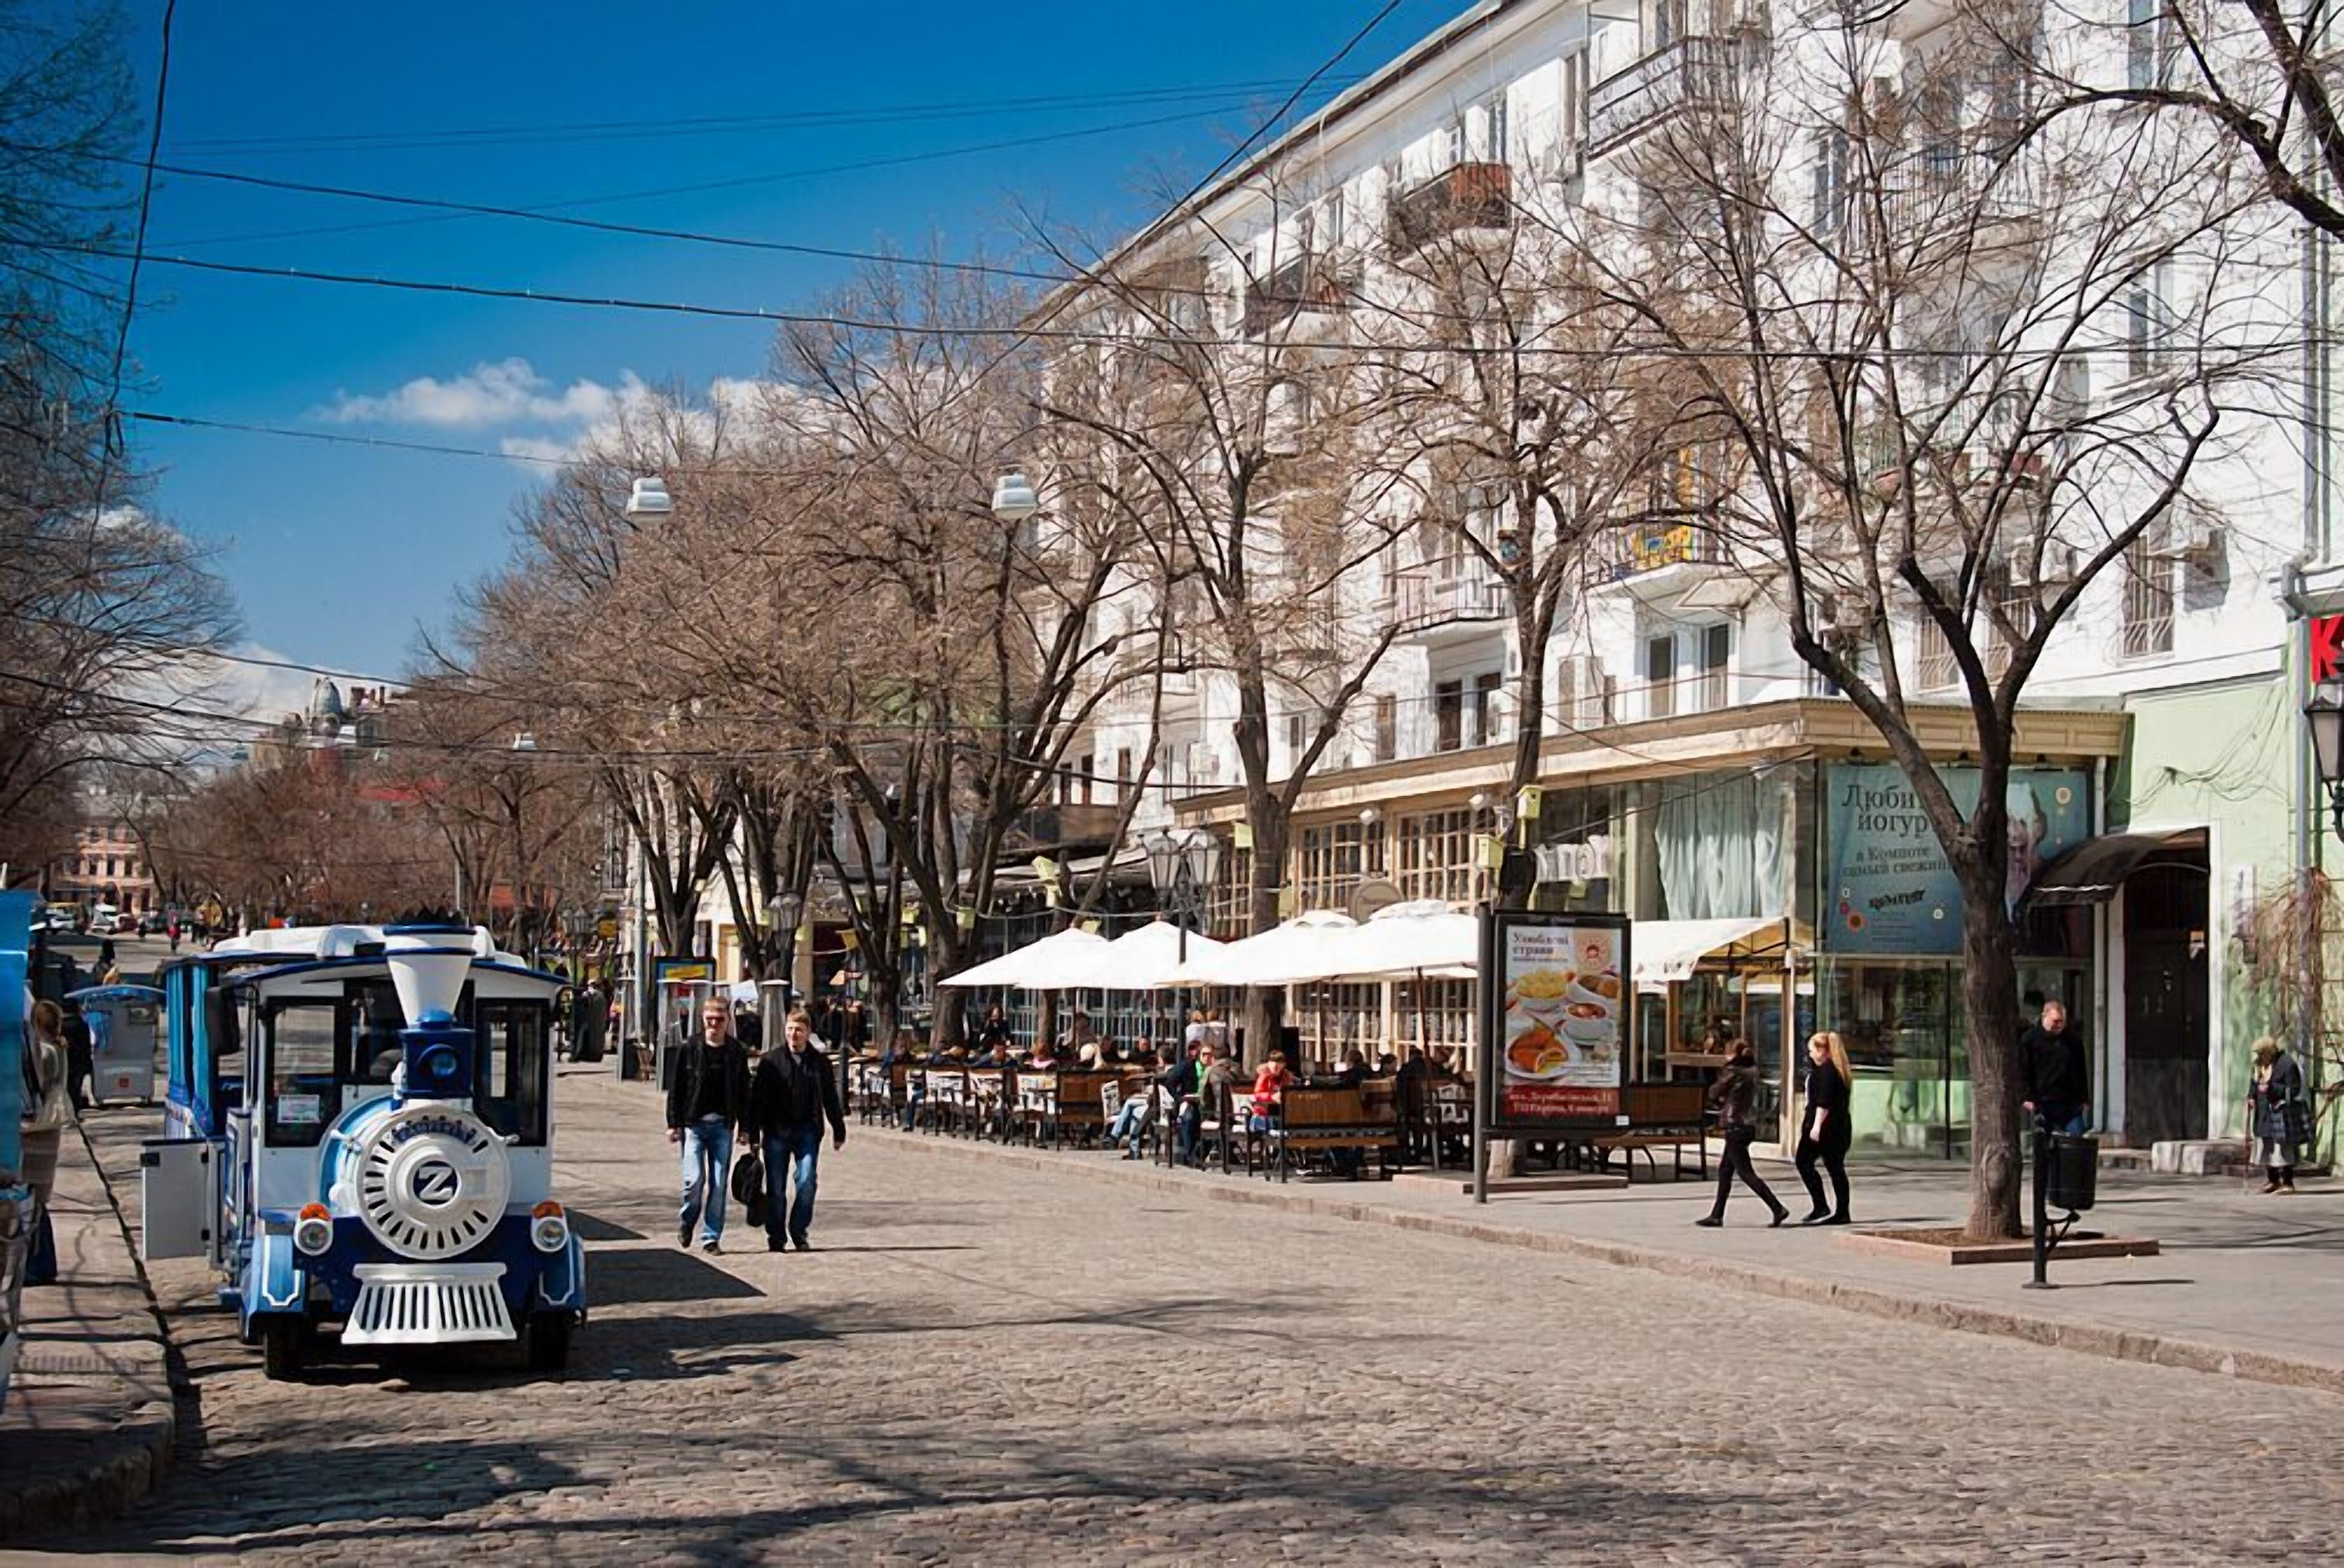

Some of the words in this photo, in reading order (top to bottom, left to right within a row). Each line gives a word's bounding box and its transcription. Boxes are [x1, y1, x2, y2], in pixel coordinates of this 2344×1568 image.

[1842, 785, 1924, 811] Люби
[1857, 812, 1928, 838] йогур
[418, 1165, 453, 1201] Z
